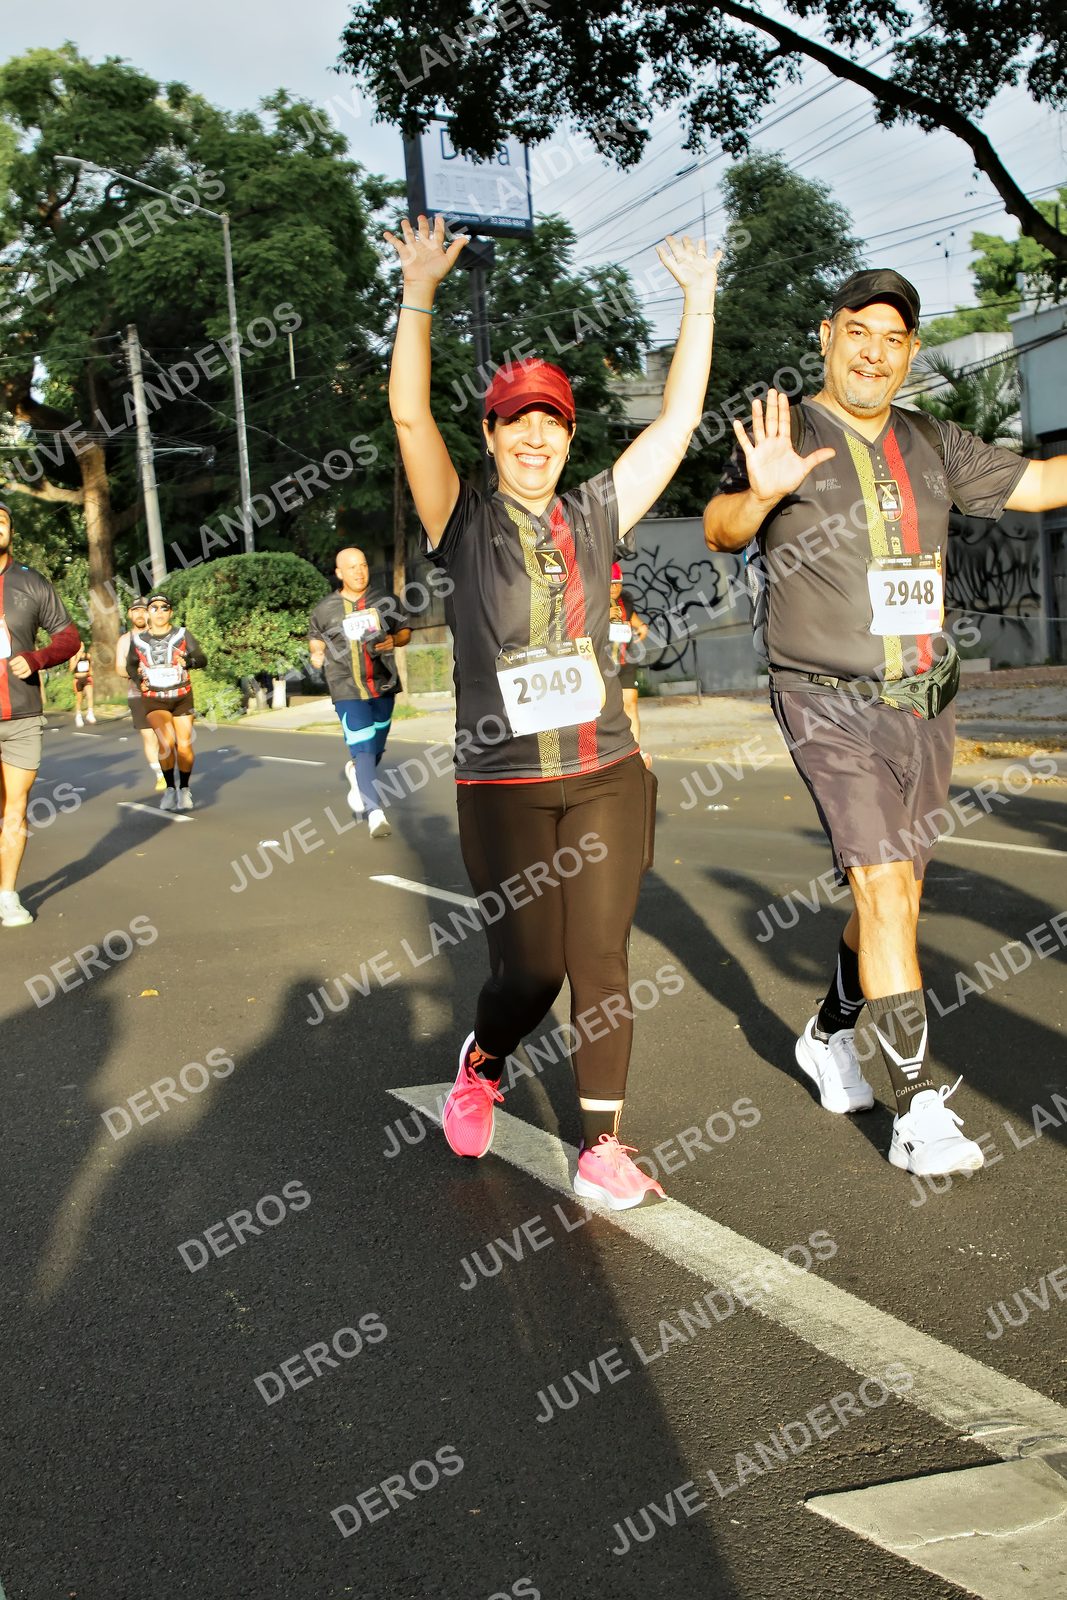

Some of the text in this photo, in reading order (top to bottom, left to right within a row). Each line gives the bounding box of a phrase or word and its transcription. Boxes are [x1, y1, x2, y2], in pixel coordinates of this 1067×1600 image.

[883, 580, 935, 606] 2948
[513, 667, 582, 705] 2949
[895, 1079, 935, 1098] Columbi
